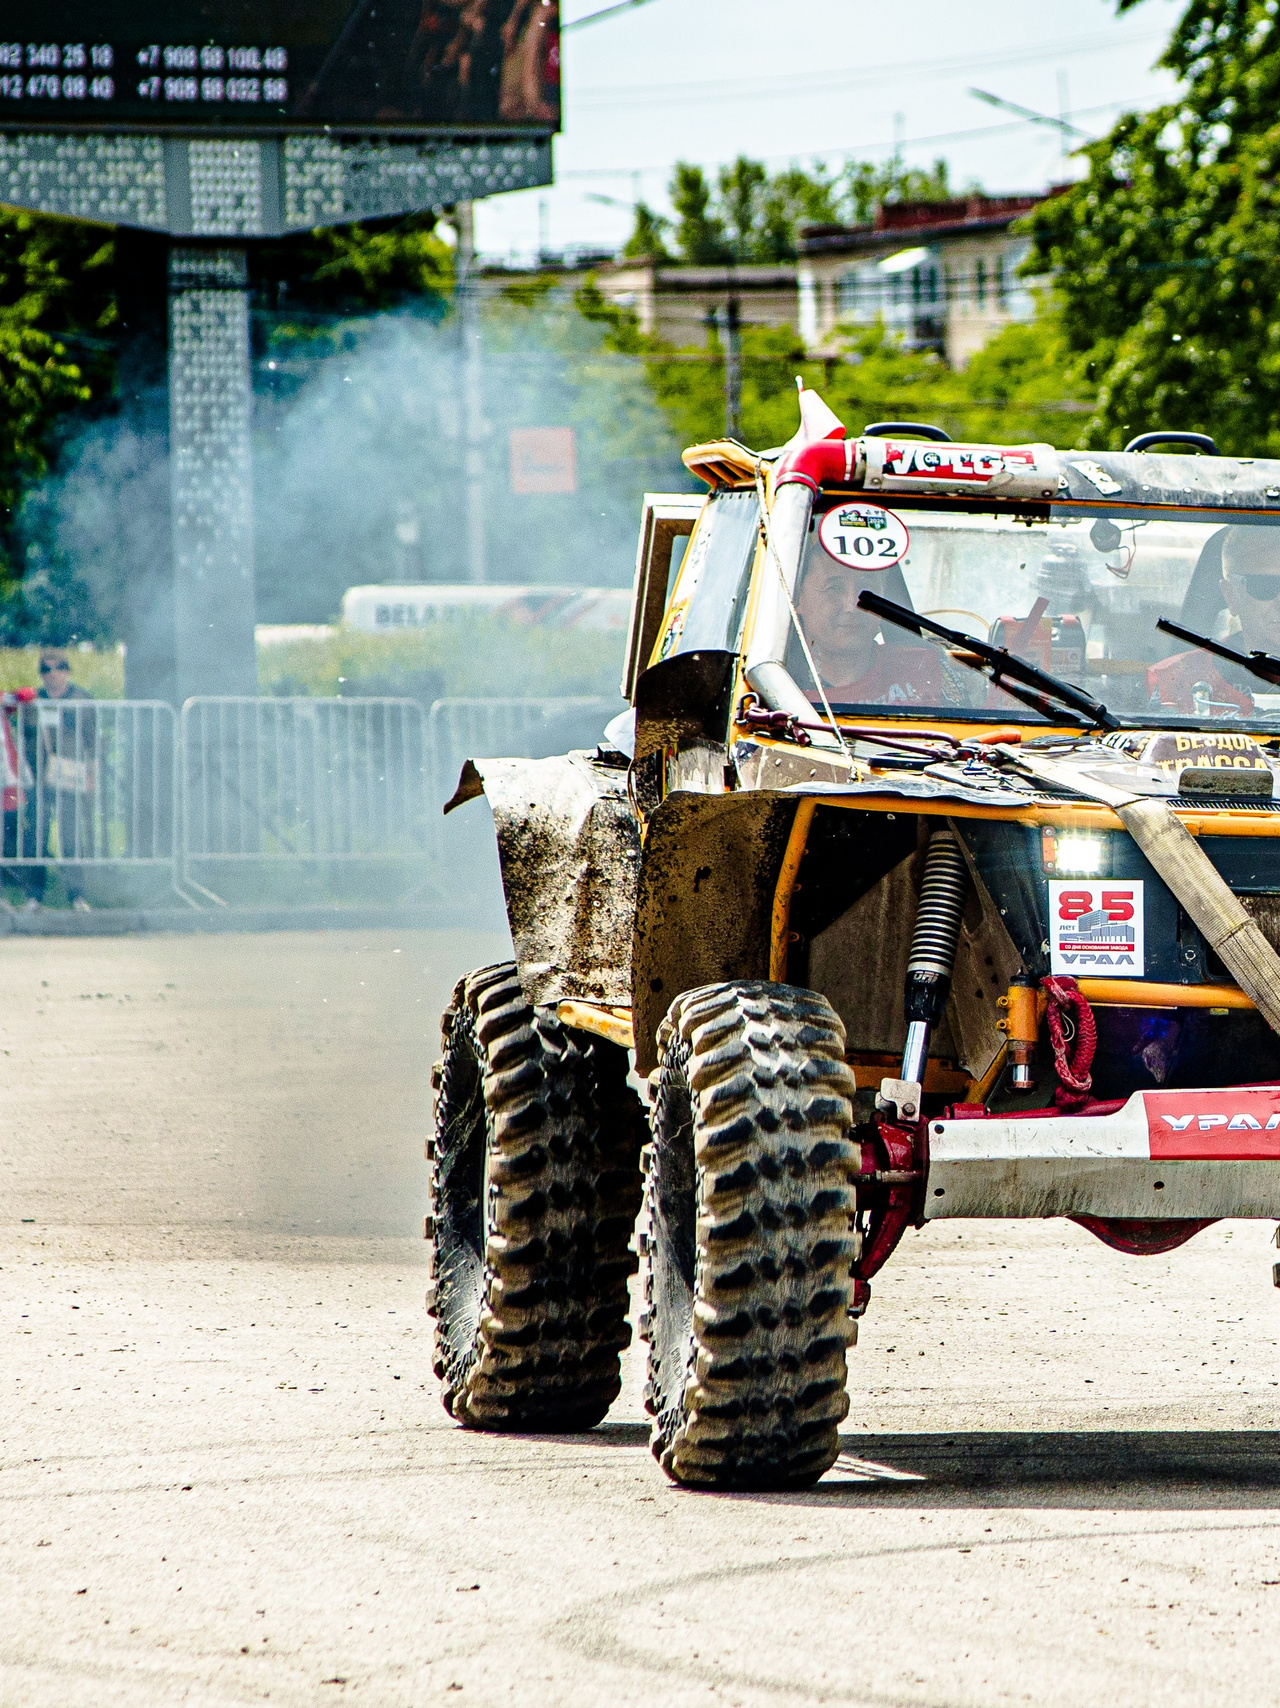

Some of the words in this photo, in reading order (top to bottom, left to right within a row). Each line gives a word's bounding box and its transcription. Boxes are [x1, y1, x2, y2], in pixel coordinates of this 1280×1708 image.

[833, 536, 898, 557] 102
[1058, 891, 1135, 920] 85
[1060, 954, 1135, 965] УРАЛ
